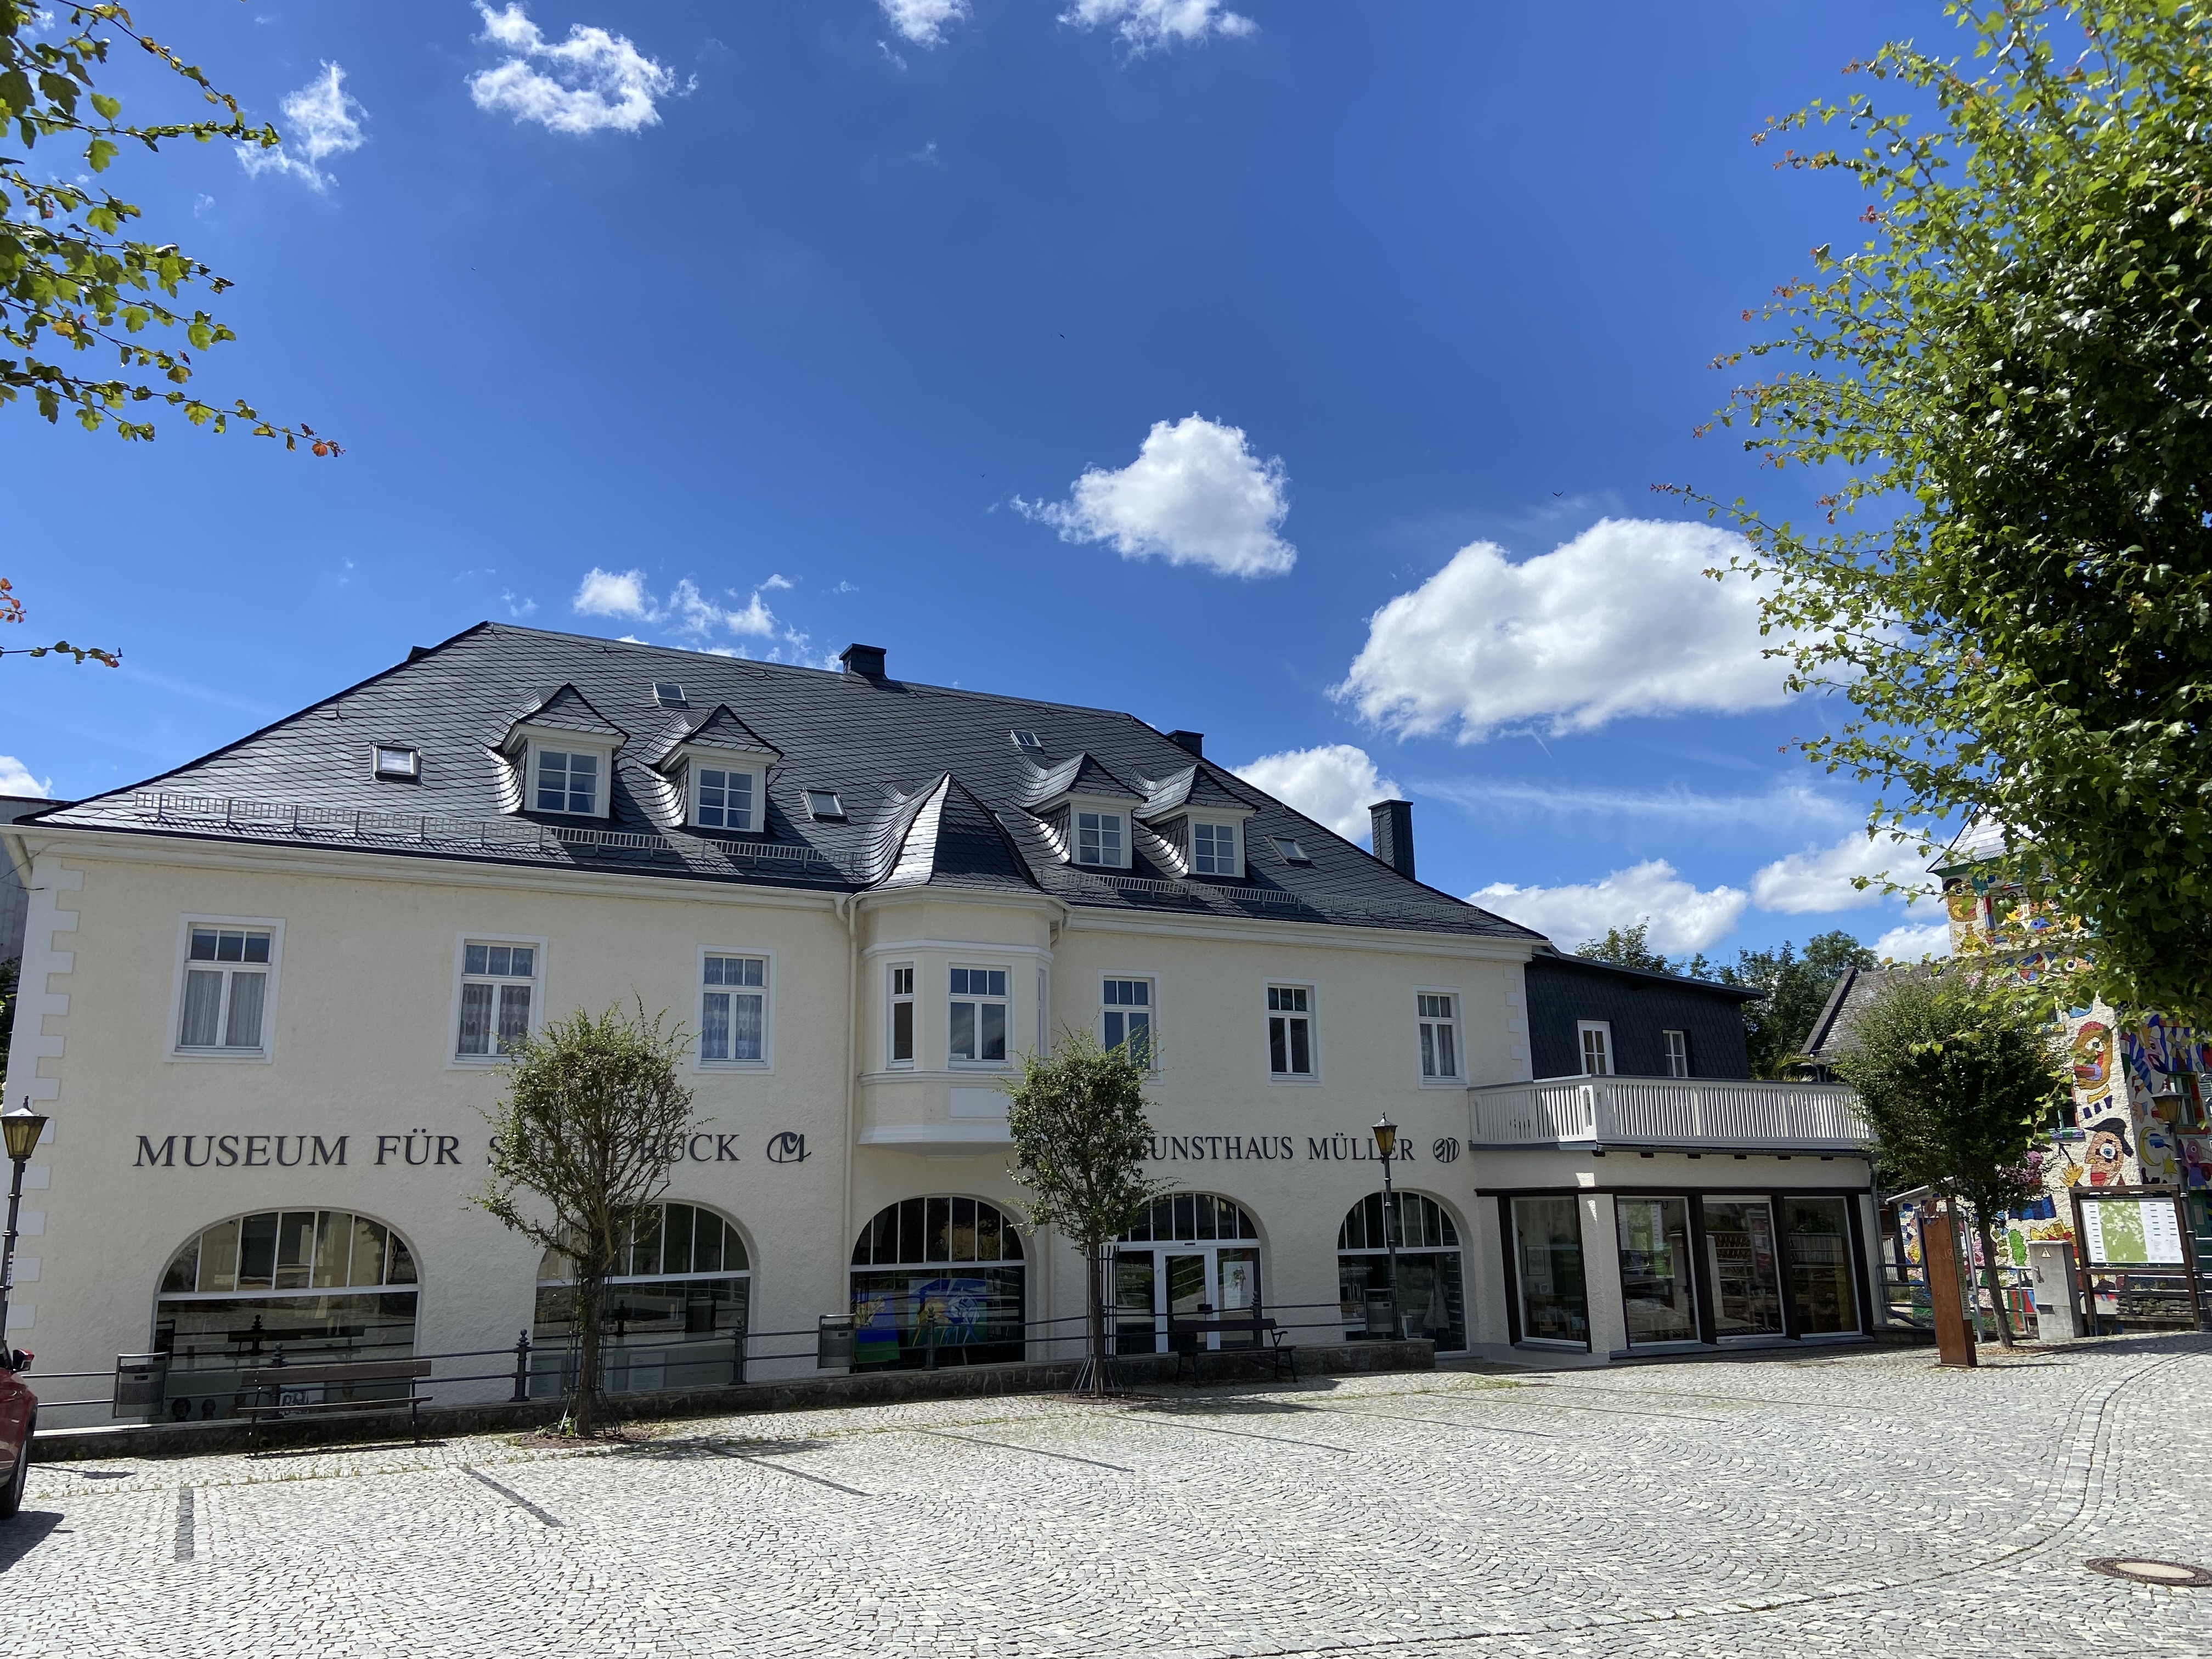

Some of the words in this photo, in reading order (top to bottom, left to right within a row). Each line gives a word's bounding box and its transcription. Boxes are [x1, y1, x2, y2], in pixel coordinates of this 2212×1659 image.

[132, 1135, 350, 1167] MUSEUM
[373, 1128, 462, 1165] FÜR
[1141, 1136, 1294, 1160] UNSTHAUS
